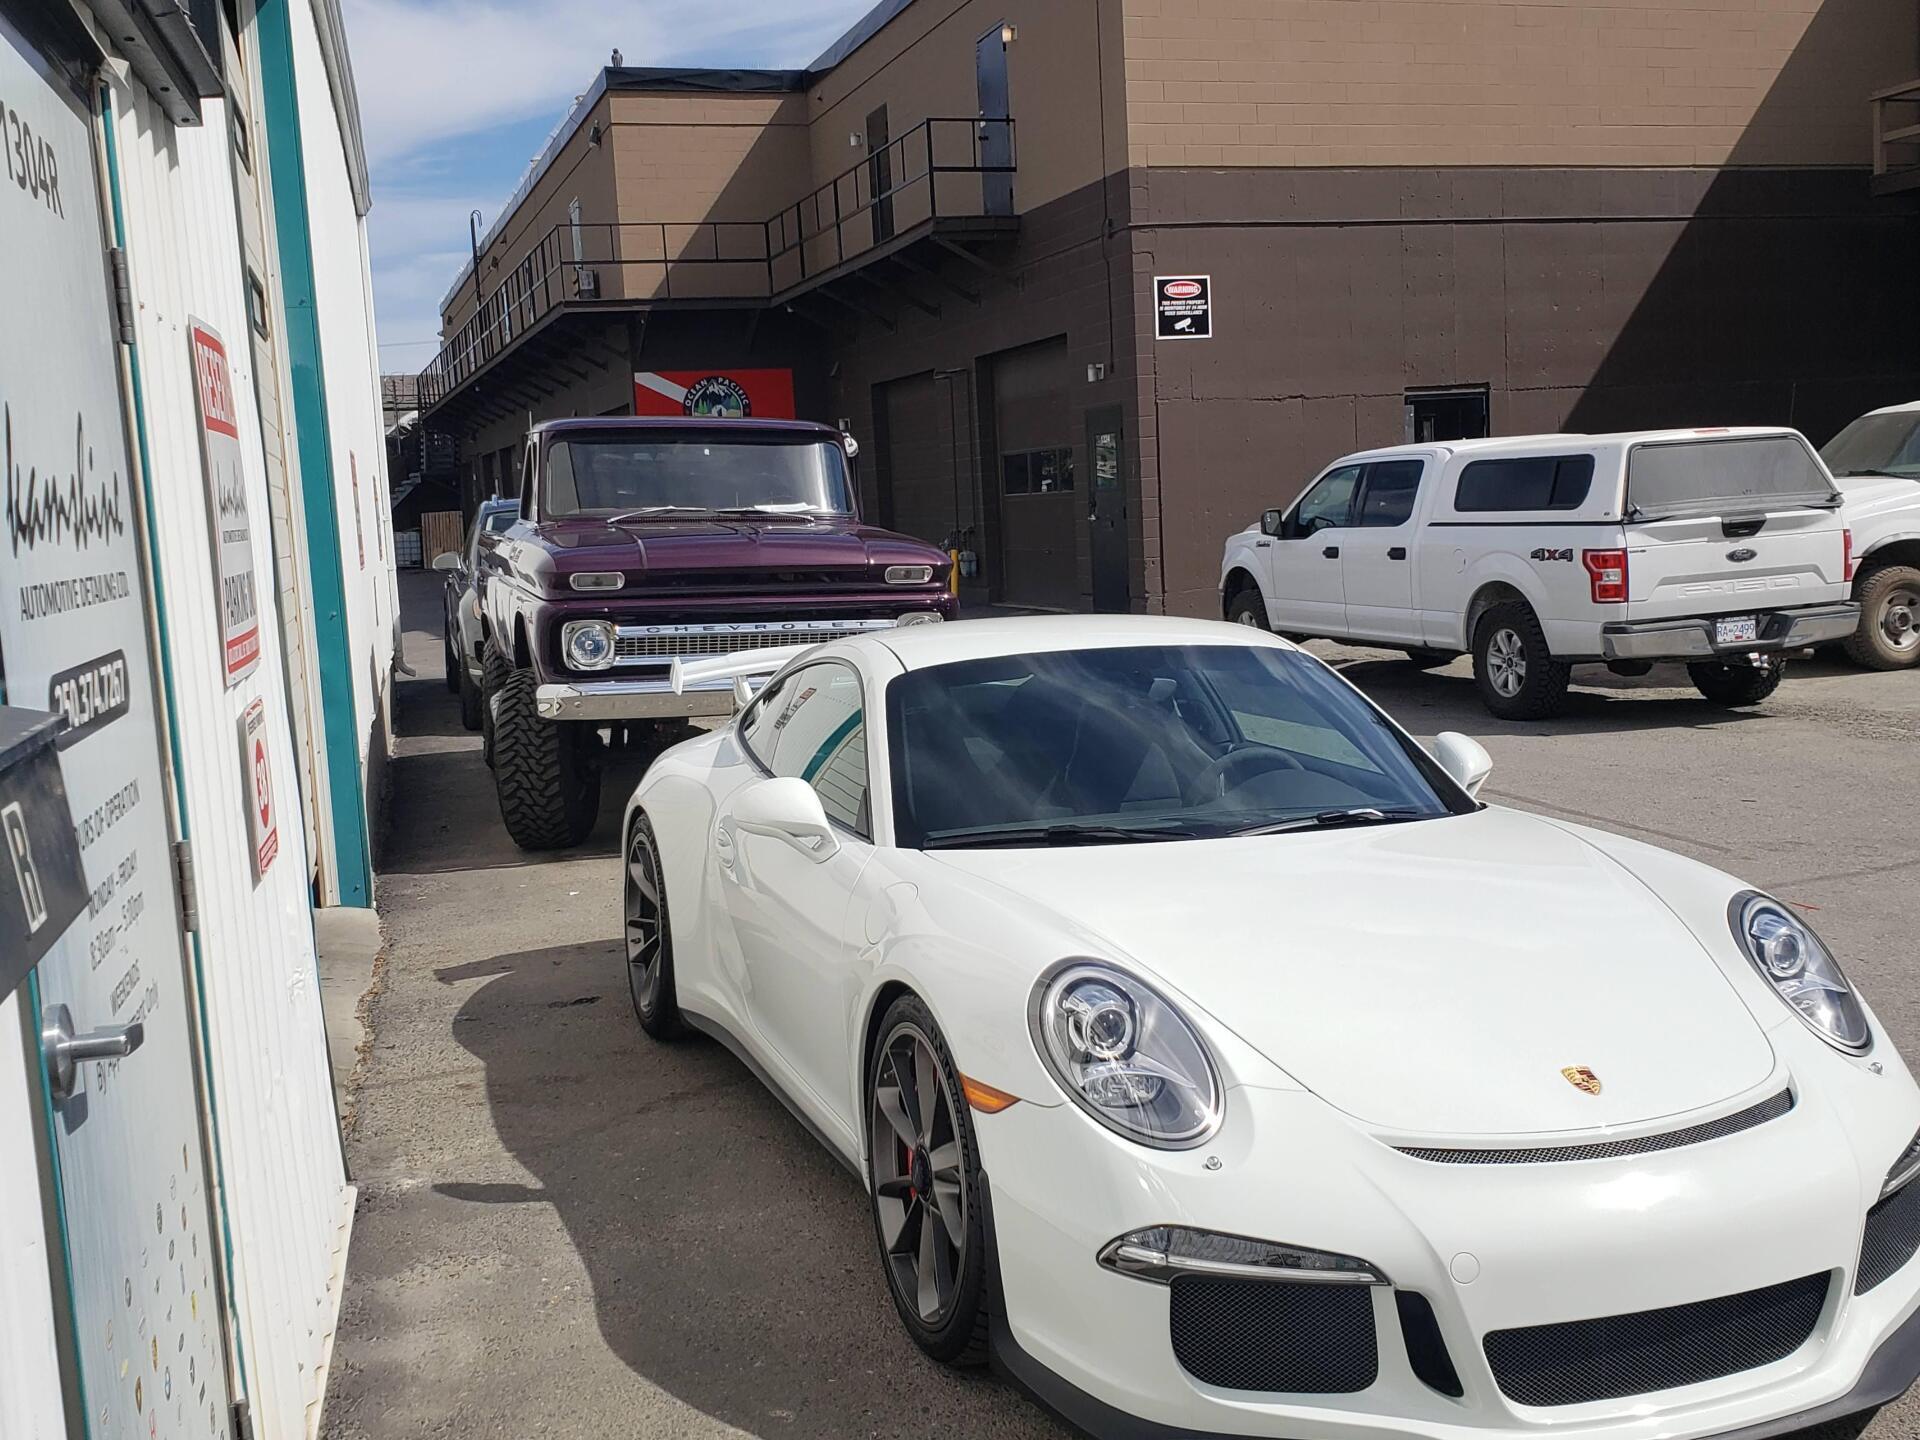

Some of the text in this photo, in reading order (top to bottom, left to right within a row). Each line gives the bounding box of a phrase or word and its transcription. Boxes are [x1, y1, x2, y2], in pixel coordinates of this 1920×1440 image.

[0, 99, 64, 220] 1304R
[1167, 285, 1199, 294] WARNING
[685, 377, 750, 407] OCEAN PACIFIC
[20, 578, 80, 621] AUTOMOTIVE
[646, 621, 867, 634] CHEVROLET
[104, 777, 141, 828] OPERATION
